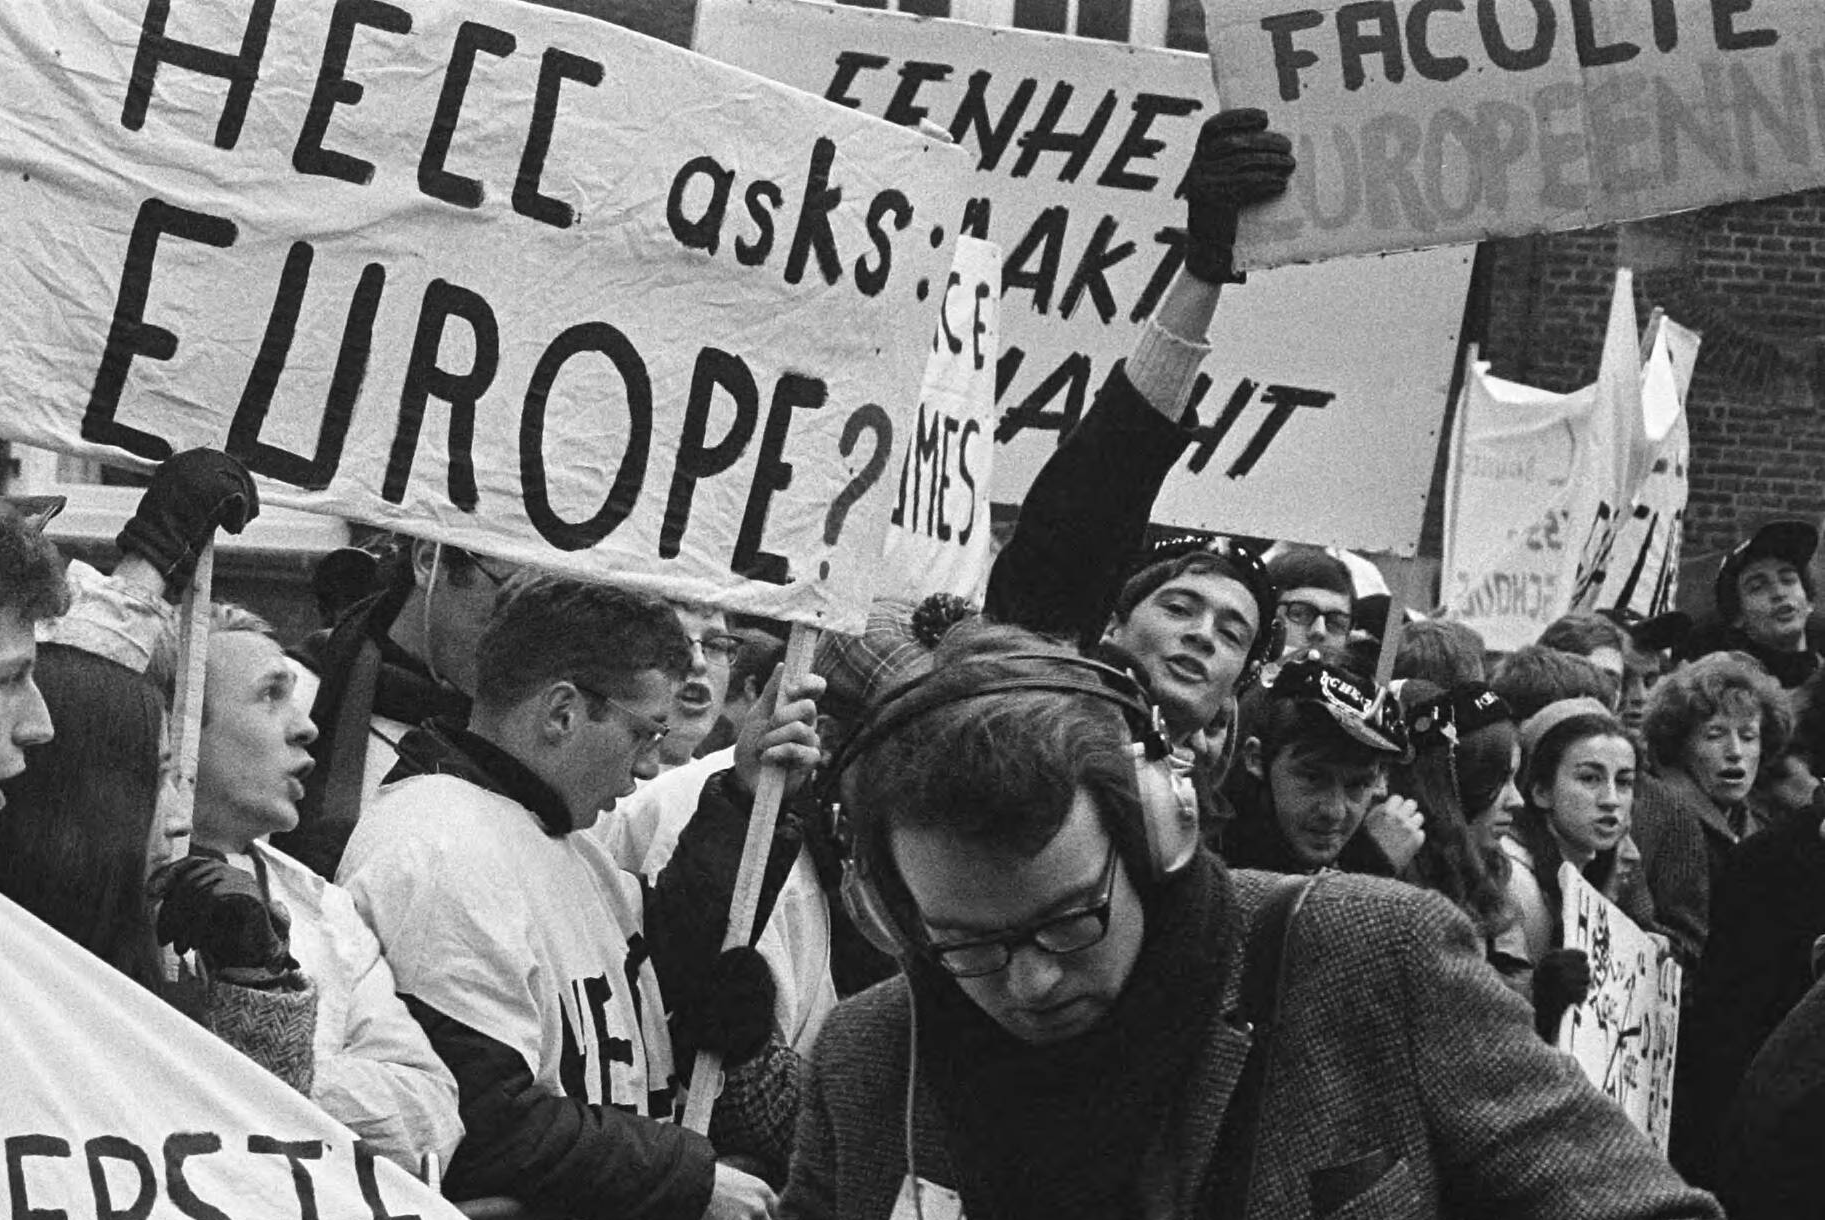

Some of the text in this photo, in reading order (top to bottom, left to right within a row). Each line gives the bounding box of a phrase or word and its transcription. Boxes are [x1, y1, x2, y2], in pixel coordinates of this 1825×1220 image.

[824, 50, 1204, 191] EENHE
[1236, 46, 1825, 241] UROPEENN
[666, 136, 944, 302] asks:
[959, 198, 1187, 323] AKT
[81, 198, 894, 586] EUROPE?
[932, 270, 991, 371] CE
[891, 402, 981, 547] MES
[994, 347, 1336, 480] AHT
